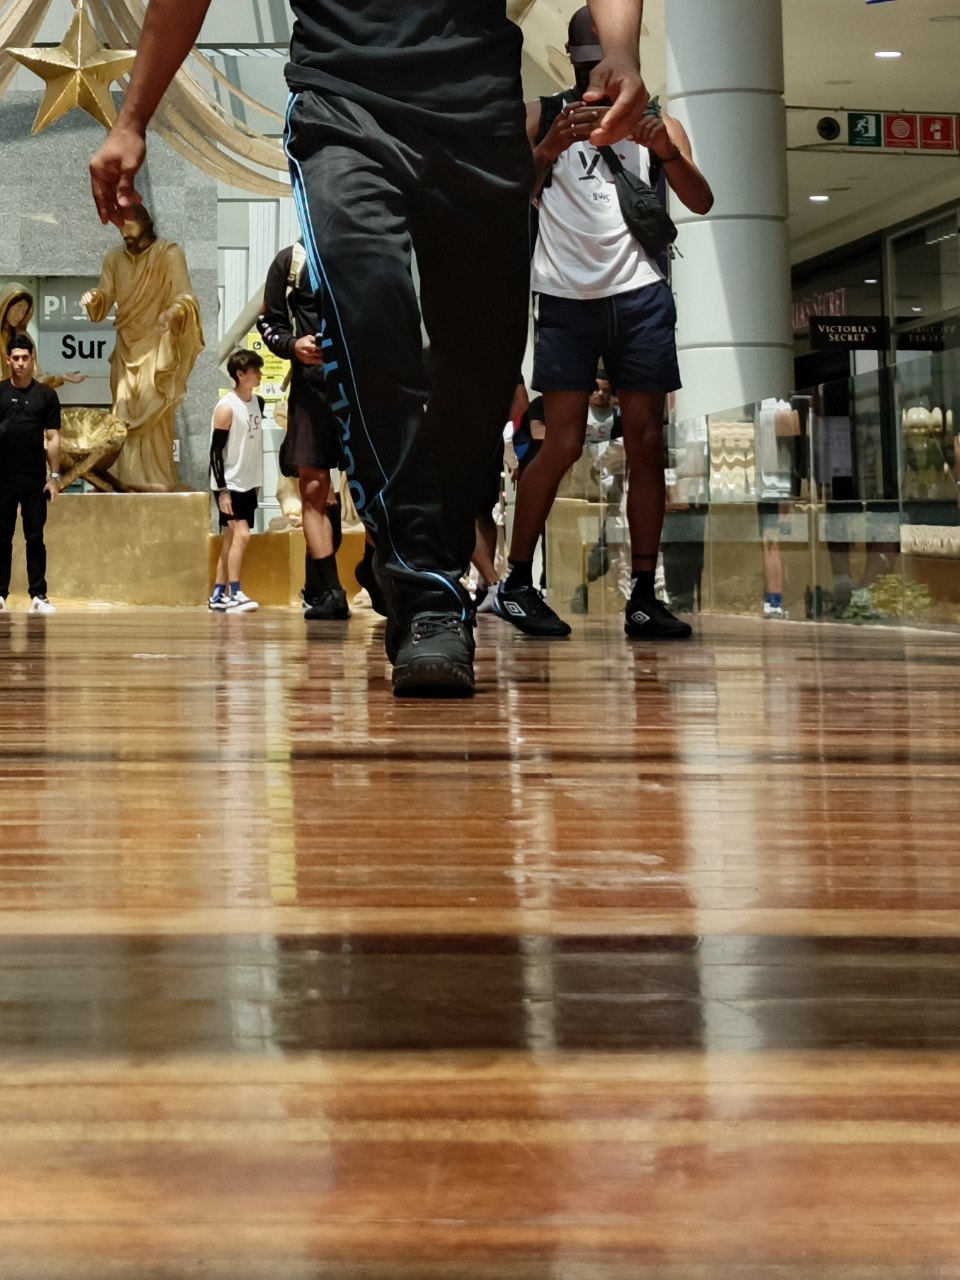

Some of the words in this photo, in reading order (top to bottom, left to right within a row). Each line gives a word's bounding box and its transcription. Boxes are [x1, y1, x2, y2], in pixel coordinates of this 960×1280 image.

[818, 324, 878, 334] VICTORIA'S
[829, 333, 866, 342] SECRET
[61, 334, 106, 359] Sur
